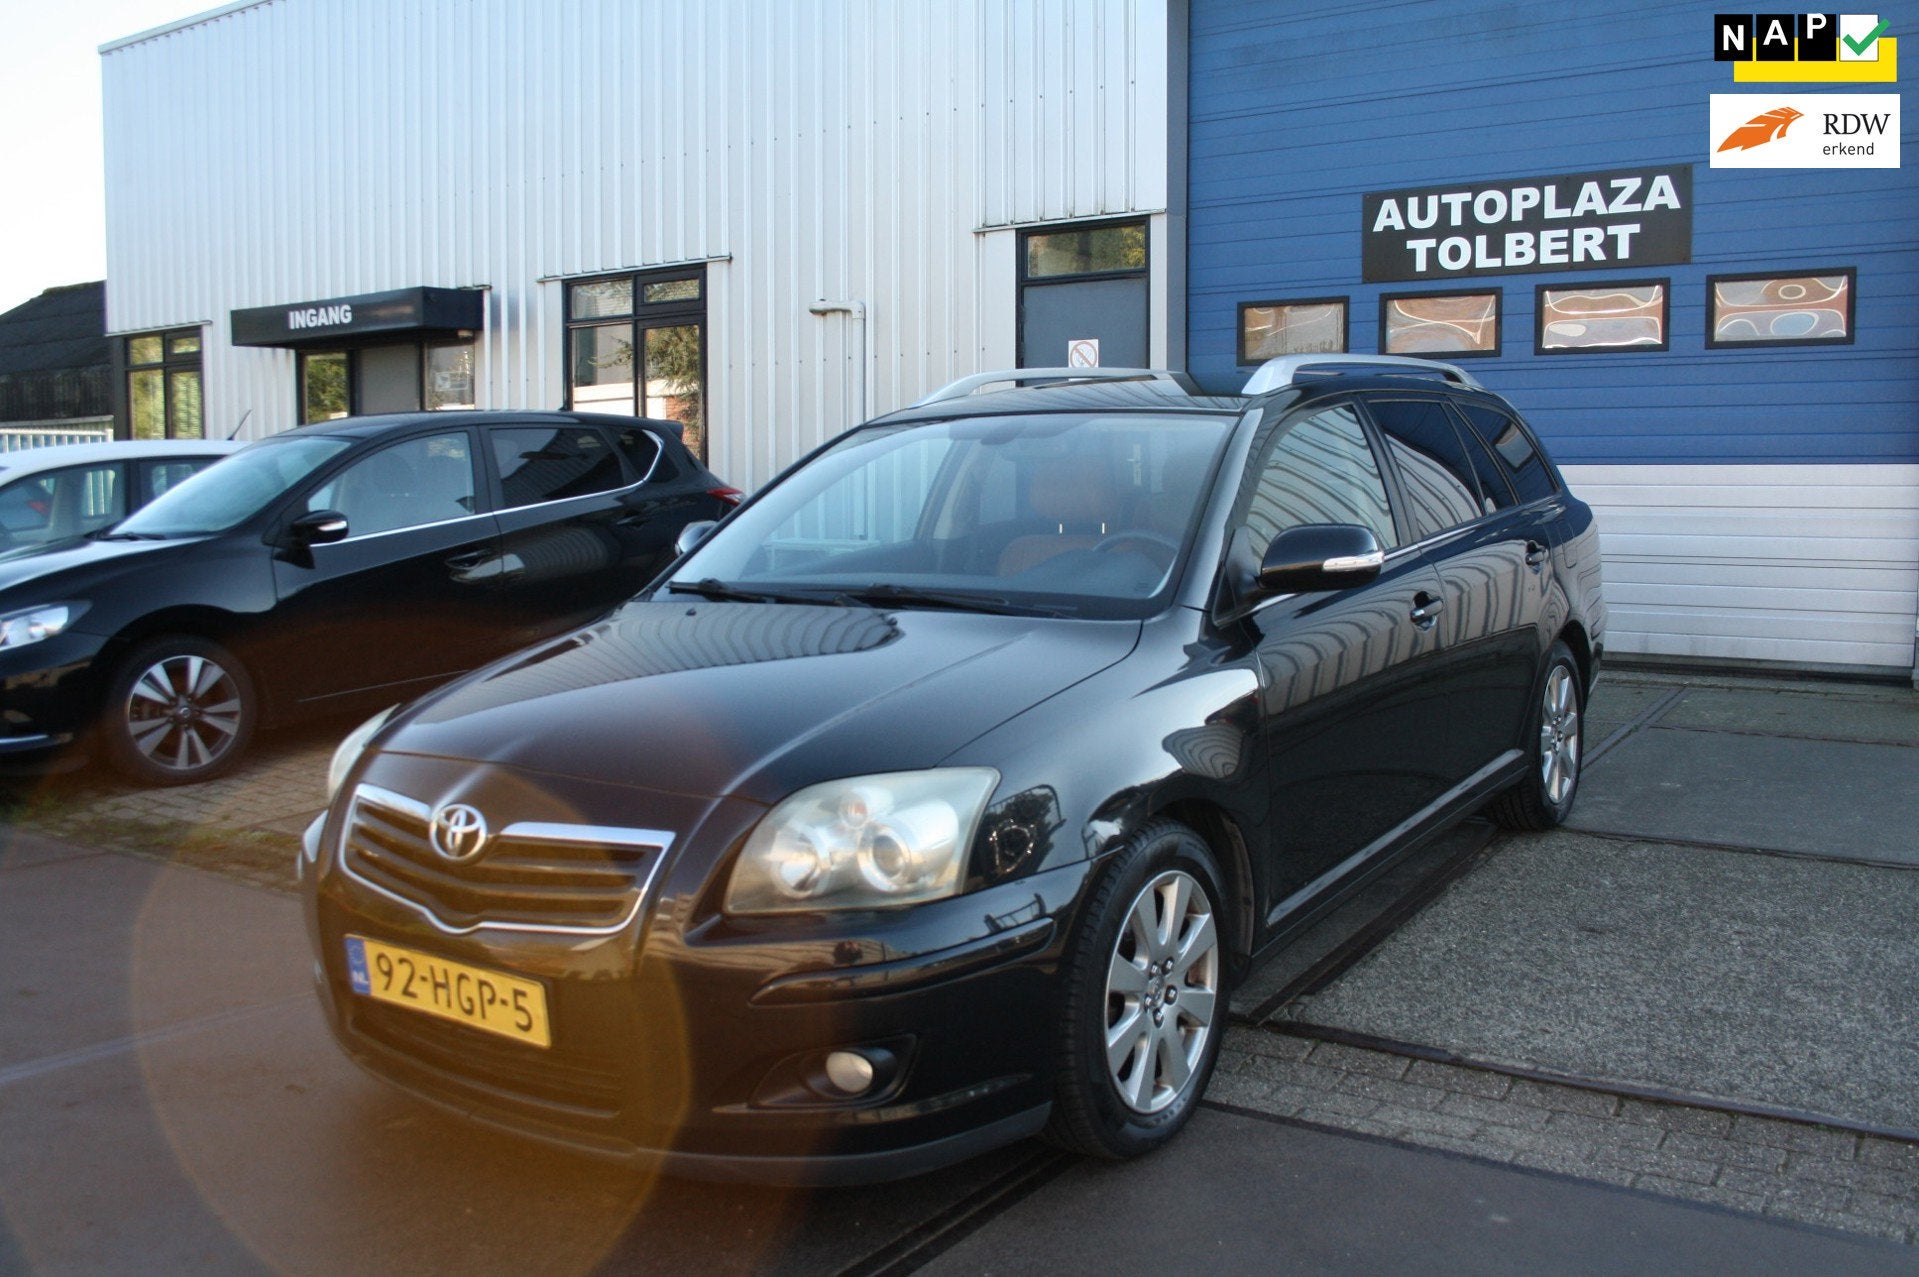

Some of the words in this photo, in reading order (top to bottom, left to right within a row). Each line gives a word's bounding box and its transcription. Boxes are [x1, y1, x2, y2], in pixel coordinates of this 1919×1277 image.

[1372, 174, 1681, 232] AUTOPLAZA
[1406, 223, 1641, 272] TOLBERT
[288, 304, 352, 329] INGANG
[376, 952, 534, 1032] 92-HGP-5
